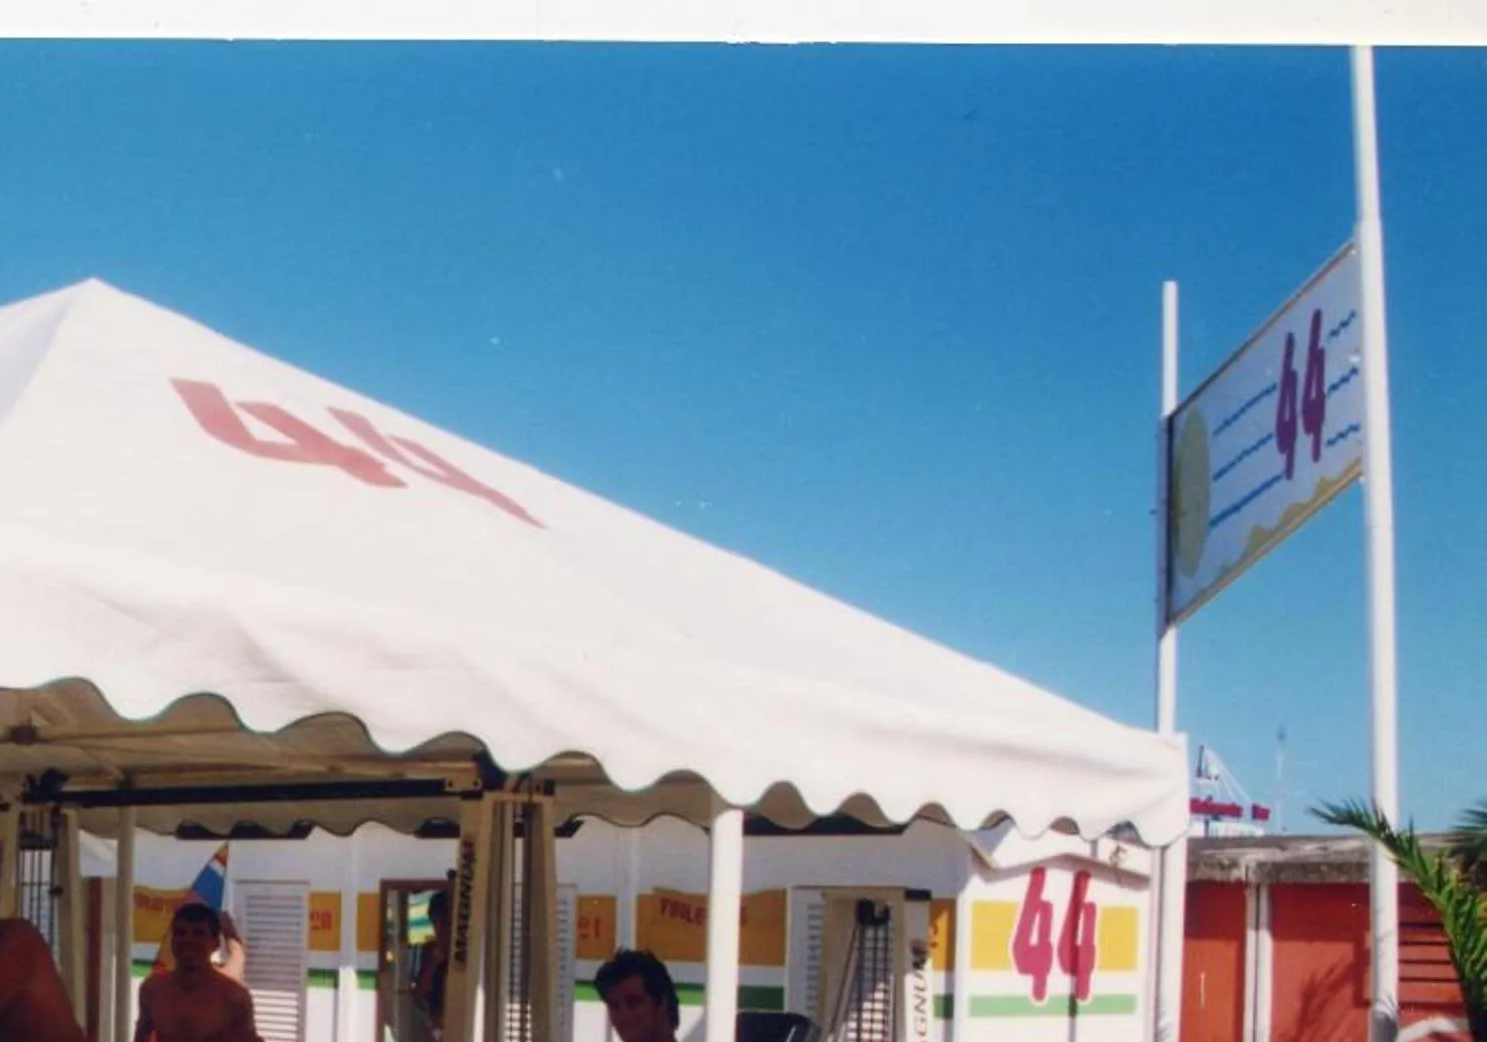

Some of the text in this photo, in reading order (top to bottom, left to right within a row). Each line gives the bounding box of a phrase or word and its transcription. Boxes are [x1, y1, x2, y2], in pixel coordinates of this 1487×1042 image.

[170, 377, 548, 529] 44
[1275, 308, 1326, 481] 44
[1014, 866, 1097, 1001] 44
